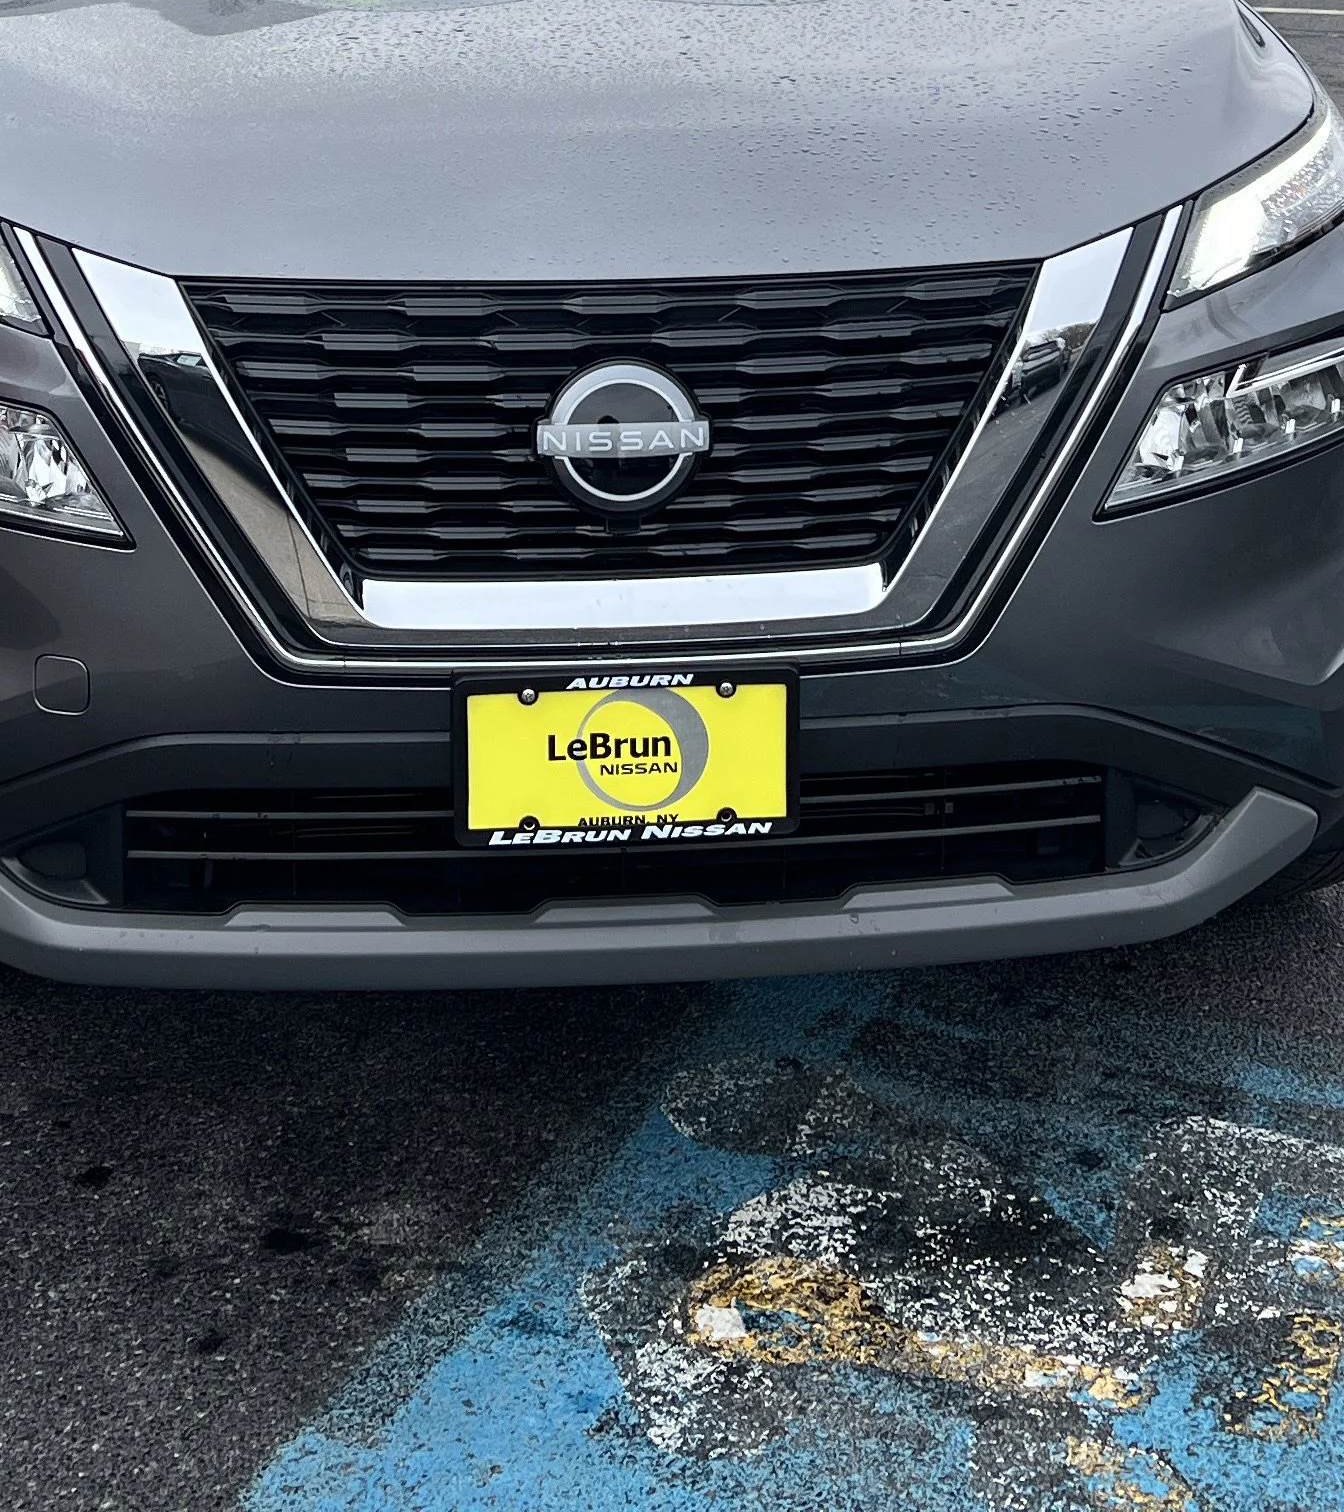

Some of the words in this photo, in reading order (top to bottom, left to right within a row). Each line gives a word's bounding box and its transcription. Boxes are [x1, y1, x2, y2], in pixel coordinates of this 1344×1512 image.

[542, 426, 705, 452] NISSAN
[565, 673, 695, 690] AUBURN
[547, 732, 672, 762] LeBrun
[599, 761, 679, 776] NISSAN
[656, 813, 679, 826] NY
